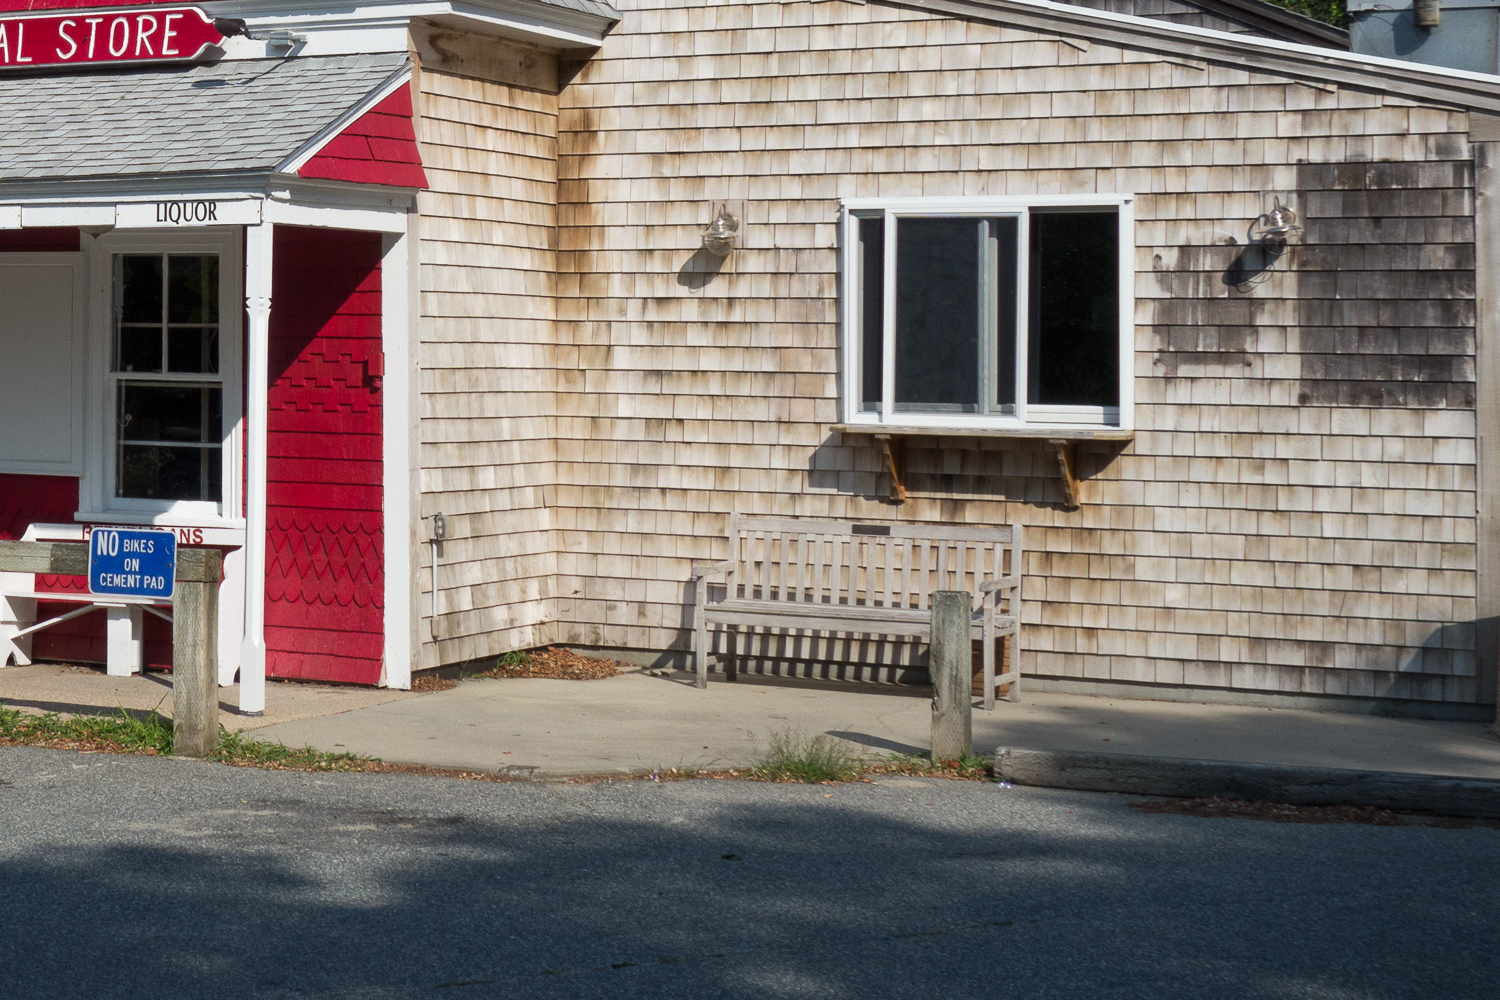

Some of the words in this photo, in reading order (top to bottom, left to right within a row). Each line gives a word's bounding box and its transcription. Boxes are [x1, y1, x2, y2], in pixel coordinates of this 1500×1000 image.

[56, 13, 184, 59] STORE
[156, 202, 218, 225] LIQUOR
[97, 531, 119, 557] NO
[123, 540, 155, 554] BIKES
[124, 558, 140, 572] ON
[100, 573, 141, 588] CEMENT
[144, 576, 165, 590] PAD
